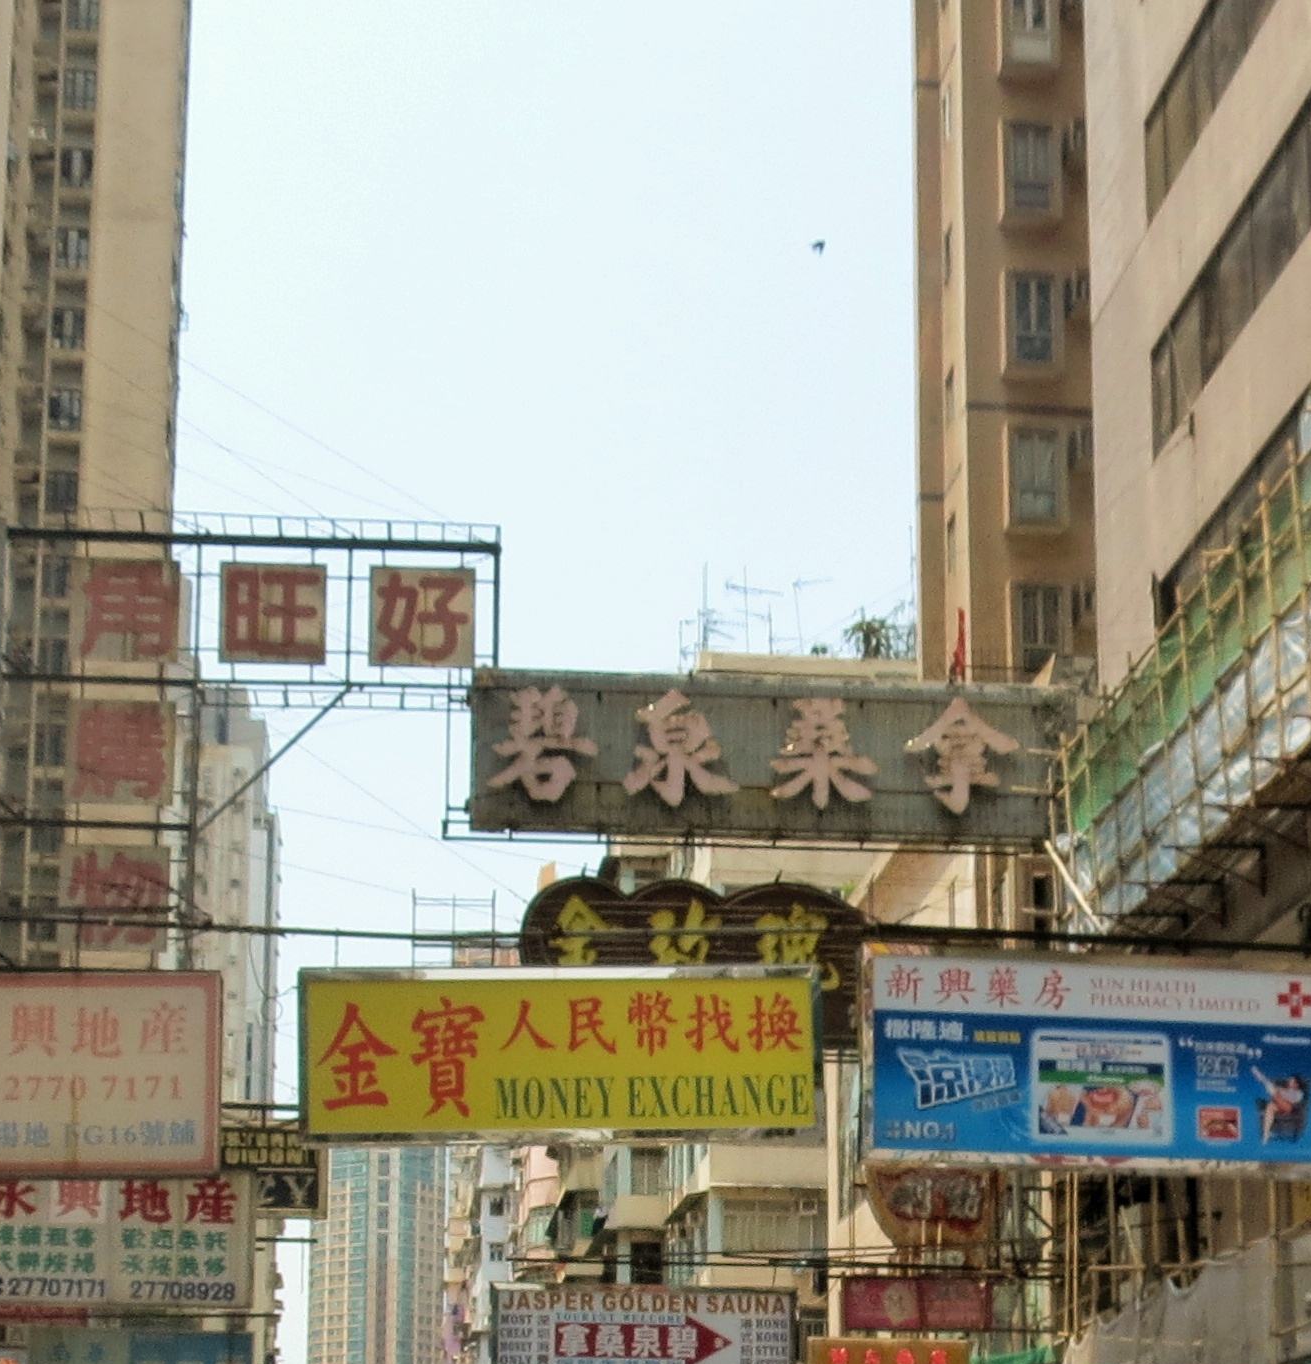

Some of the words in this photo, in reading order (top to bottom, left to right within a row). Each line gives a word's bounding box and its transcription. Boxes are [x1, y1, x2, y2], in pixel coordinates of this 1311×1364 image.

[488, 683, 1021, 816] 碧泉桑拿
[884, 963, 1073, 1011] 新興藥房
[499, 989, 805, 1058] 人民幣找換
[315, 995, 487, 1119] 金寶
[4, 1075, 89, 1102] 2770
[100, 1075, 184, 1102] 7171
[495, 1076, 615, 1120] MONEY
[627, 1073, 810, 1119] EXCHANGE
[7, 1278, 107, 1299] 27707171
[129, 1281, 236, 1302] 27708928
[501, 1292, 595, 1312] JASPER
[601, 1293, 699, 1314] GOLDEN
[705, 1294, 788, 1316] SAUNA
[499, 1314, 534, 1325] MOST
[755, 1318, 788, 1330] HONG
[499, 1327, 533, 1339] CHEAP
[755, 1331, 788, 1343] KONG
